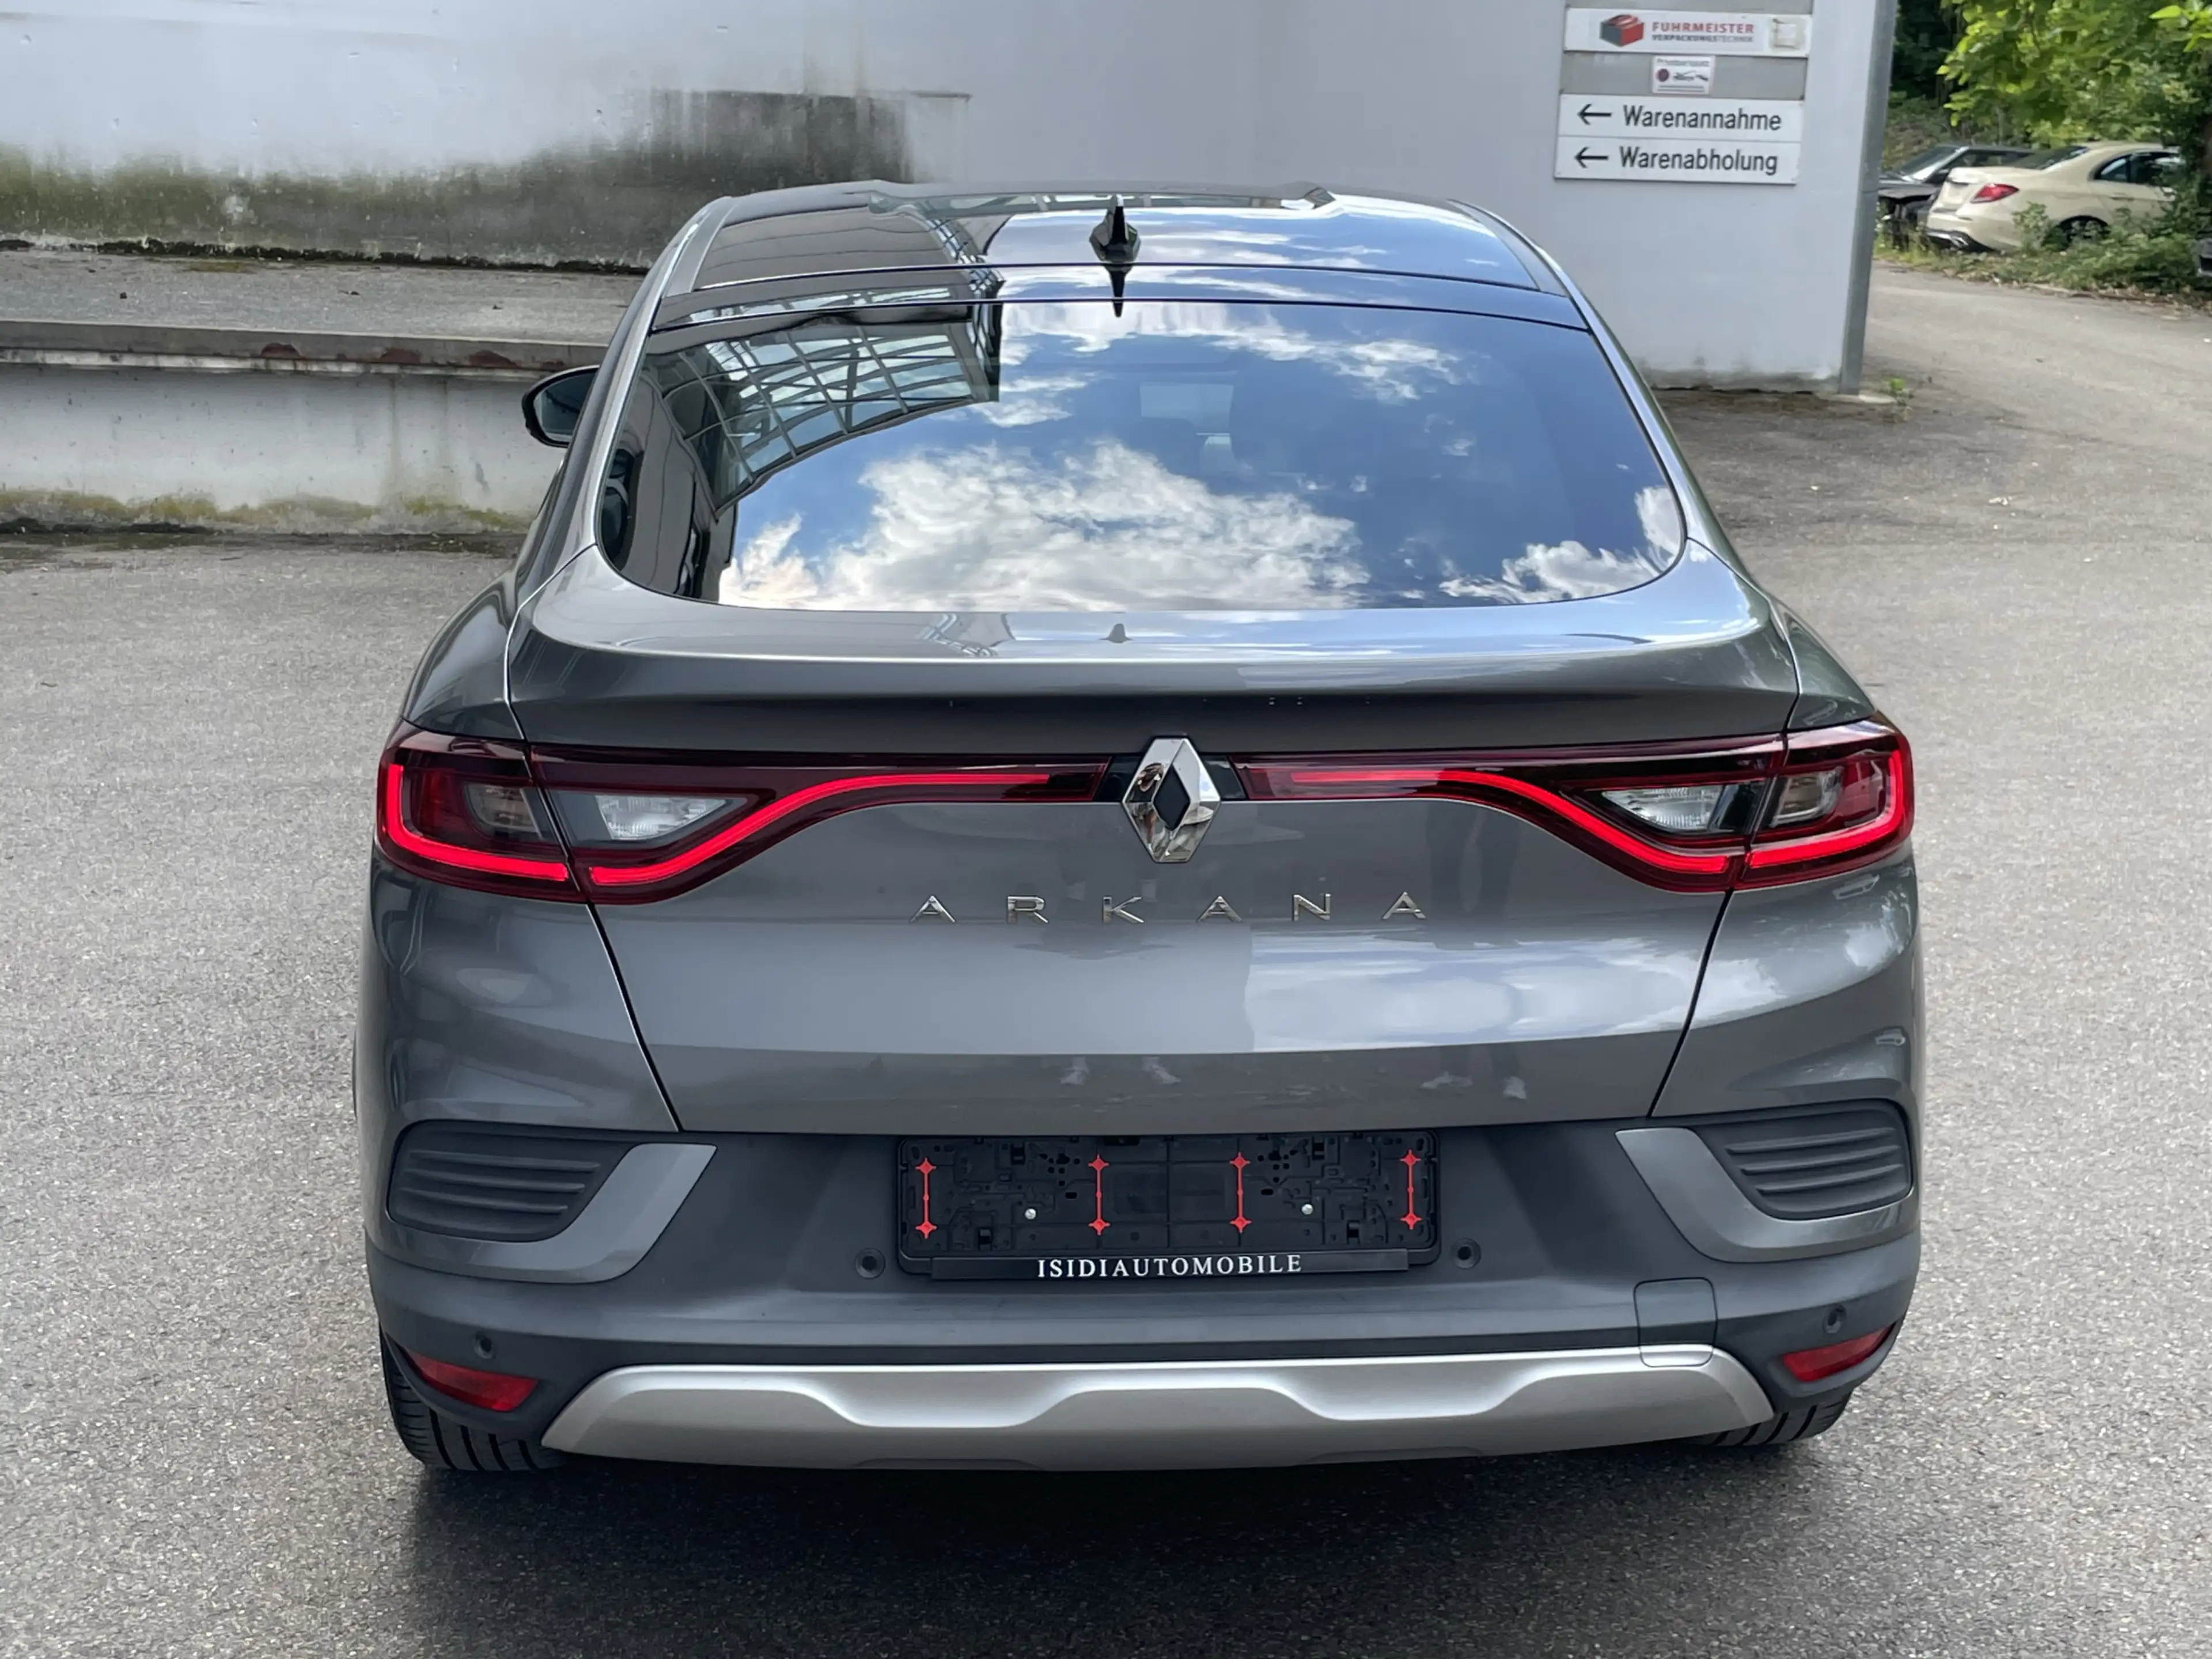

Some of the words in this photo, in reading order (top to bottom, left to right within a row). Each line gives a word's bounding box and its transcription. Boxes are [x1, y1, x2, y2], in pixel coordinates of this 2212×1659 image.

[1623, 104, 1782, 131] Warenannahme
[1619, 146, 1778, 176] Warenabholung
[910, 892, 1427, 923] ARKANA
[1037, 1254, 1302, 1278] ISIDIAUTOMOBILE
